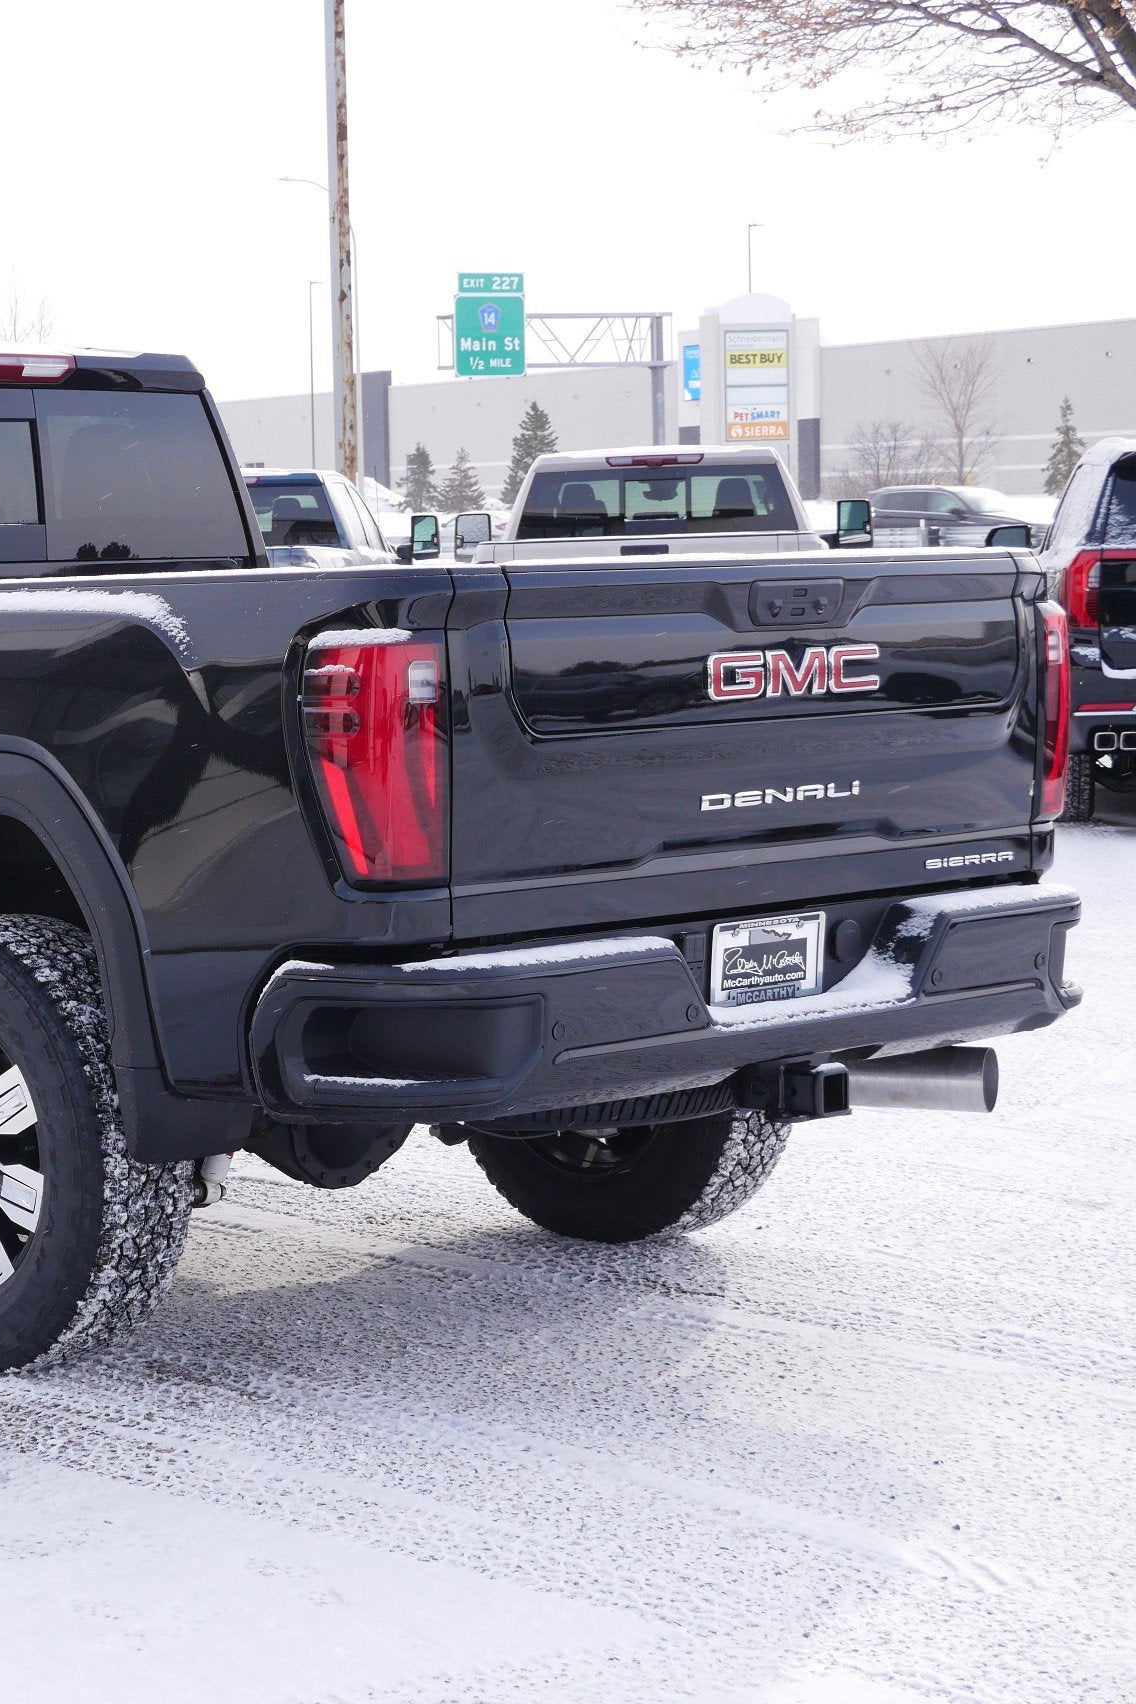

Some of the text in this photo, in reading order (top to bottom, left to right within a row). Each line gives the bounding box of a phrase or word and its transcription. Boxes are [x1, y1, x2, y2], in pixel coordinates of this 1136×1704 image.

[463, 277, 519, 290] EXIT 227
[484, 312, 496, 326] 14
[460, 336, 520, 351] Main St
[489, 358, 512, 368] MILE
[729, 352, 783, 364] BEST BUY
[743, 425, 784, 437] SIERRA
[707, 643, 880, 701] GMC
[700, 780, 860, 812] DENALI
[925, 851, 1014, 870] SIERRA
[739, 917, 800, 929] MINNESOTA
[723, 971, 804, 989] McCarthyauto.com
[737, 986, 795, 1004] MCCARTHY
